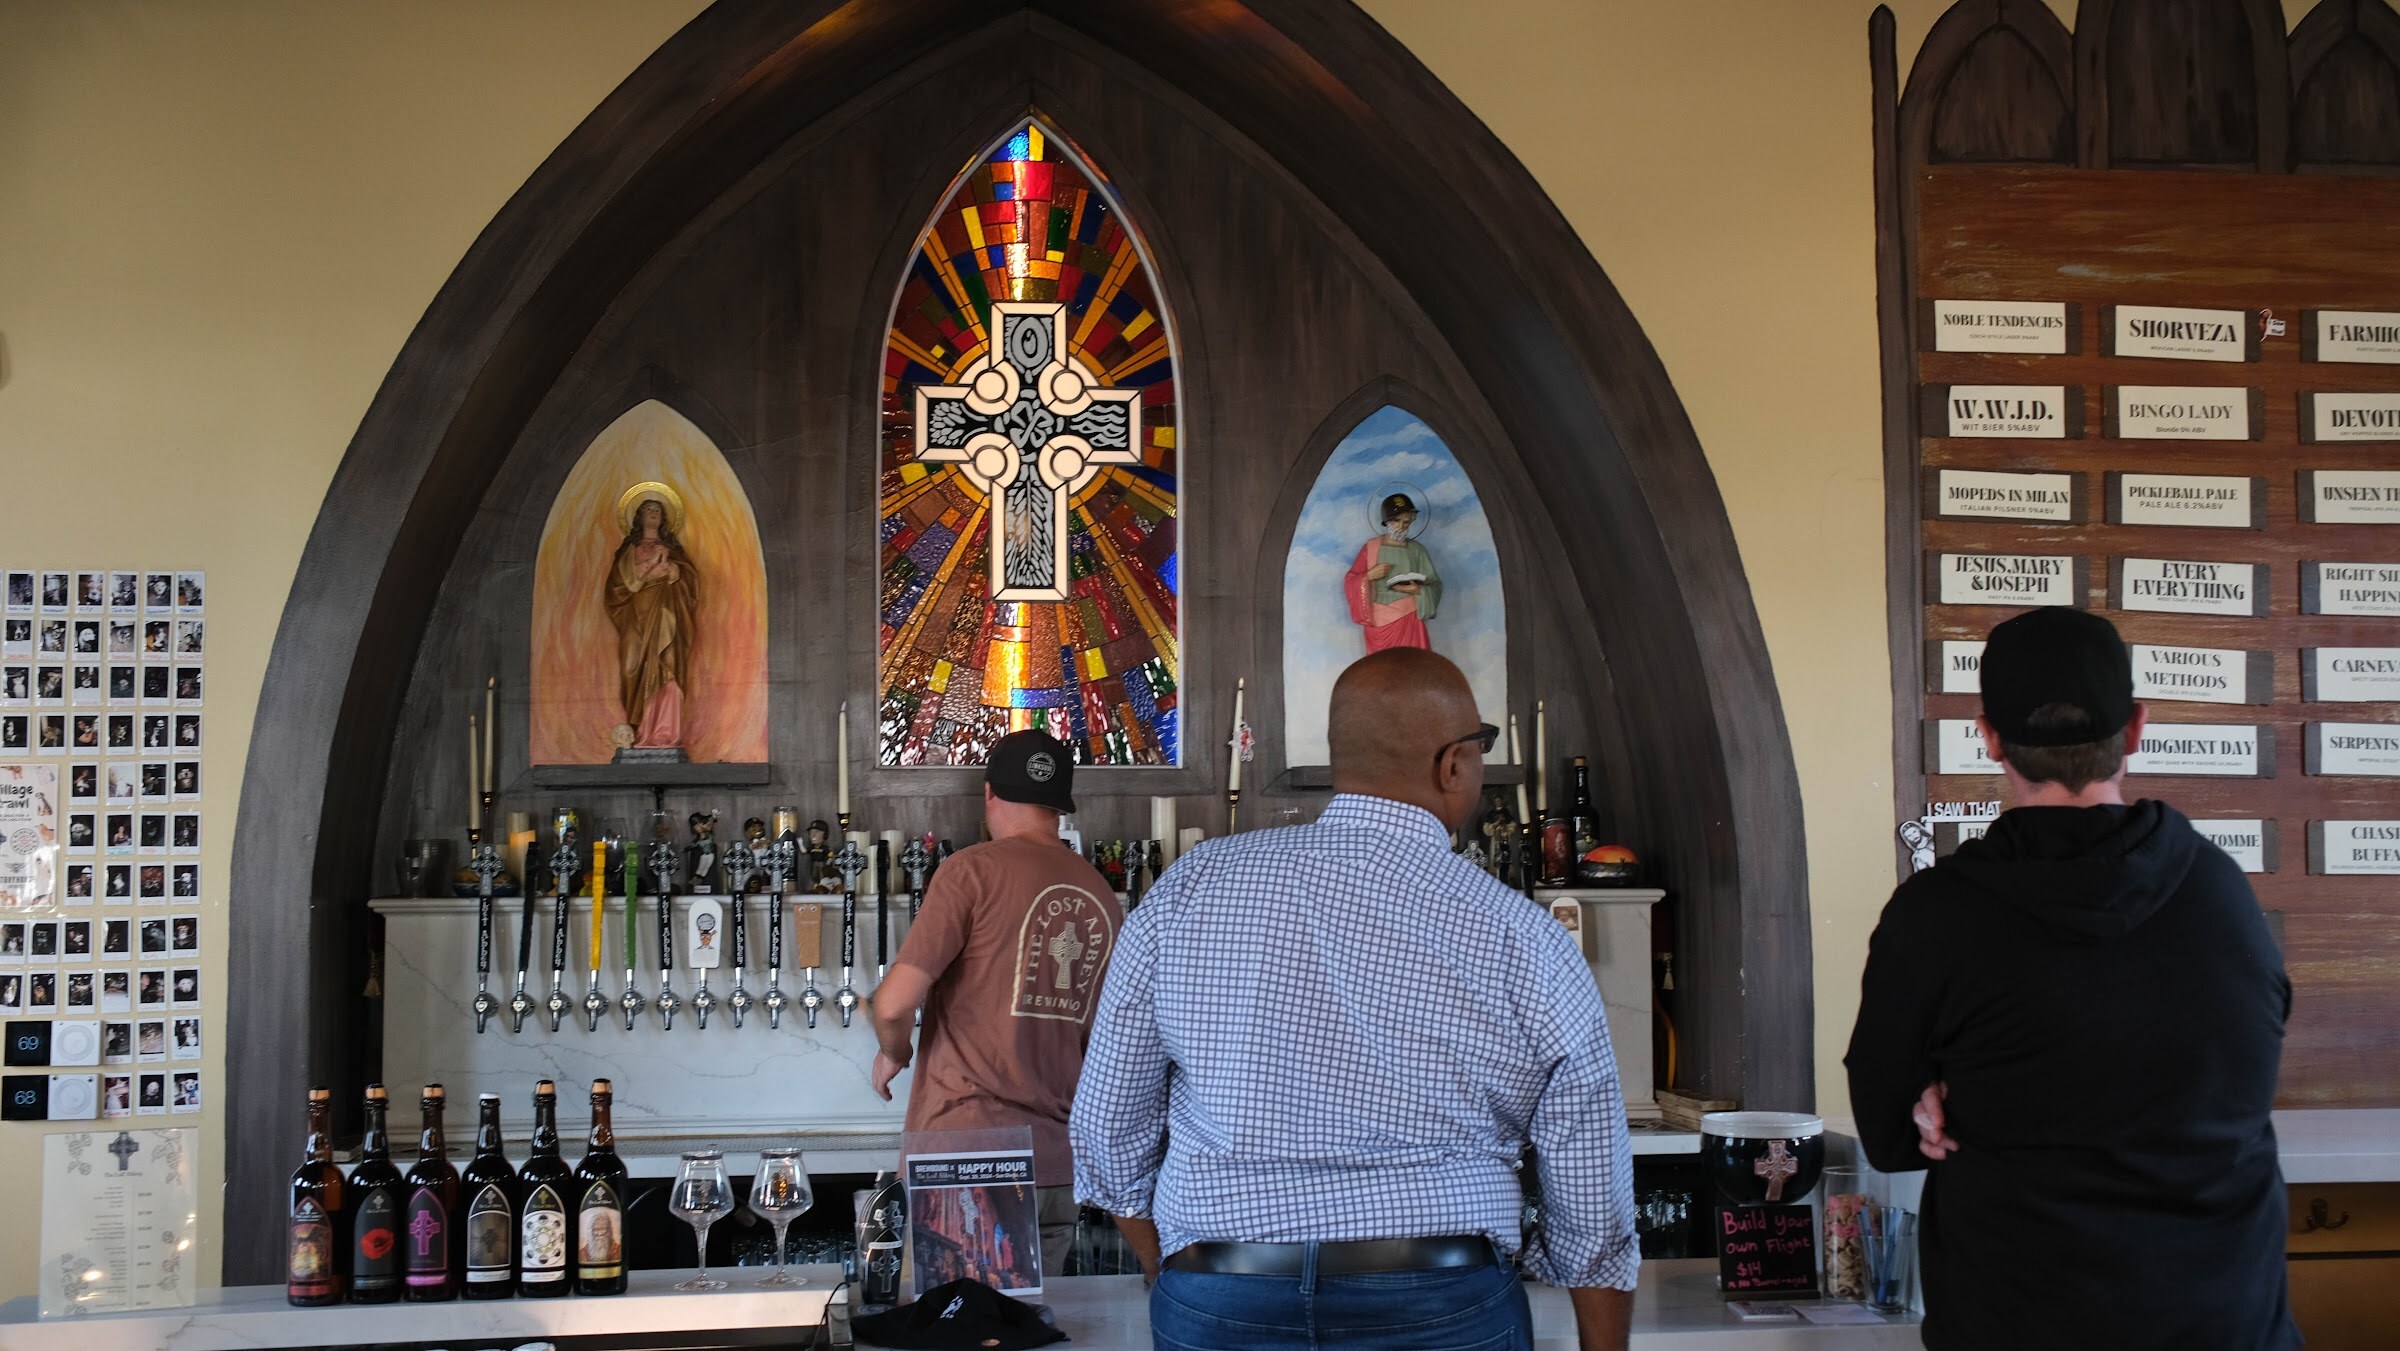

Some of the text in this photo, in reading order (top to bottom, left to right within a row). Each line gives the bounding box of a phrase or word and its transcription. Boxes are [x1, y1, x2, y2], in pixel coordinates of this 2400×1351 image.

[1943, 313, 2064, 328] NOBLE TENDENCIES
[2129, 319, 2237, 343] SHORVEZA
[1953, 399, 2053, 420] W.W.J.D.
[2128, 404, 2233, 419] BINGO LADY
[2007, 424, 2040, 432] 5%ABV
[1948, 487, 2069, 504] MOPEDS IN MILAN
[2129, 486, 2238, 500] PICKLEBALL PALE
[2324, 487, 2380, 501] UNSEEN
[1994, 505, 2027, 513] PILSNER
[2140, 500, 2162, 508] PALE
[2164, 501, 2182, 509] ALE
[2162, 563, 2221, 581] EVERY
[2326, 568, 2374, 581] RIGHT
[1971, 575, 2048, 593] &JOSEPH
[2132, 579, 2245, 601] EVERYTHING
[2151, 650, 2222, 668] VARIOUS
[2144, 672, 2228, 690] METHODS
[2139, 739, 2255, 755] UDGMENT DAY
[2330, 737, 2399, 751] SERPENTS
[0, 784, 34, 799] illage
[1926, 800, 2002, 817] I SAW THAT
[1026, 897, 1103, 994] THE LOST ABBEY
[18, 1036, 40, 1050] 69
[14, 1090, 37, 1105] 68
[957, 1161, 1027, 1174] HAPPY HOUR
[1722, 1209, 1767, 1234] Build
[1725, 1236, 1811, 1254] own Flight
[1736, 1261, 1762, 1277] $14
